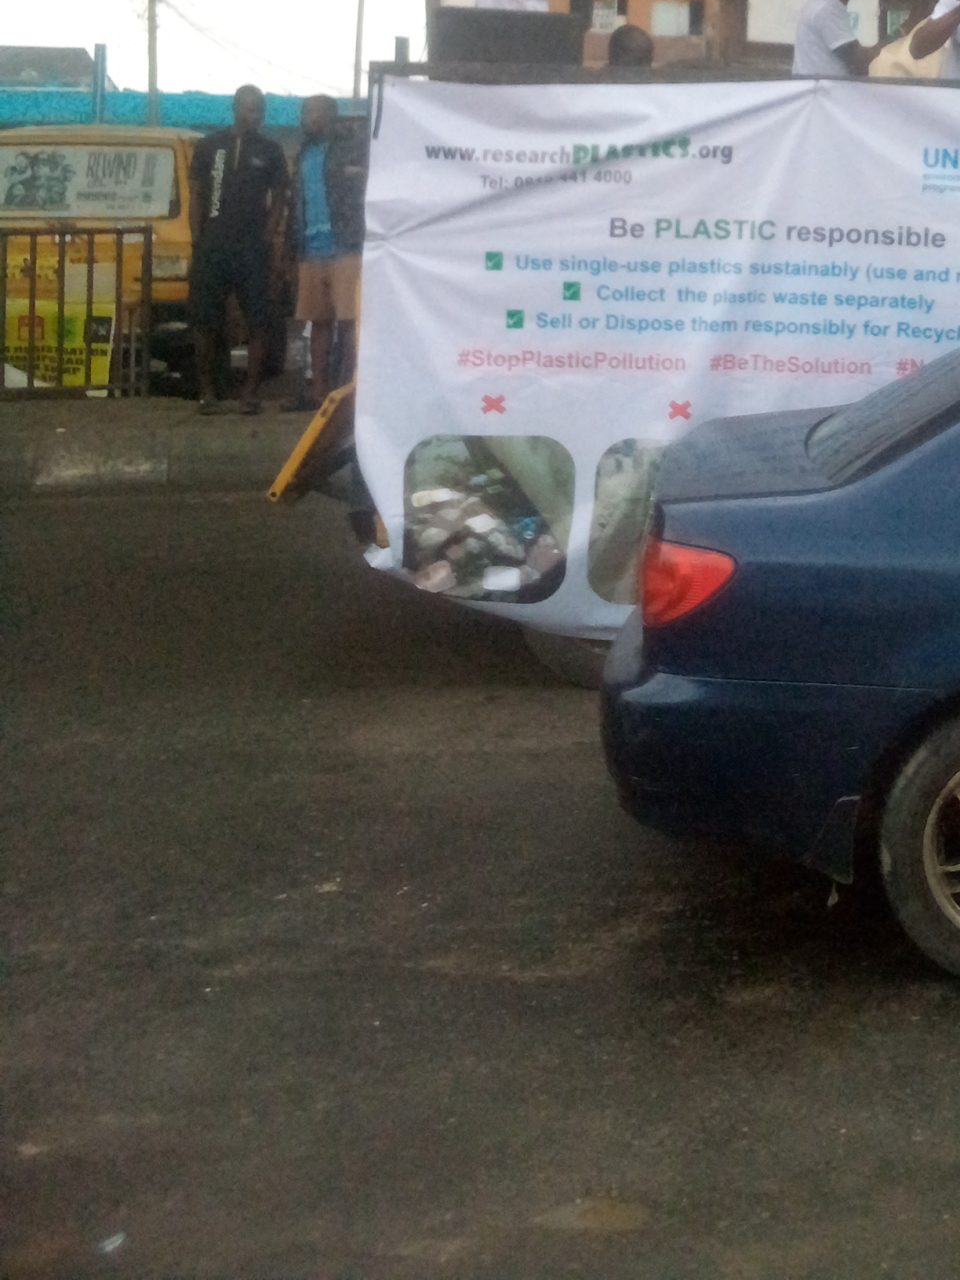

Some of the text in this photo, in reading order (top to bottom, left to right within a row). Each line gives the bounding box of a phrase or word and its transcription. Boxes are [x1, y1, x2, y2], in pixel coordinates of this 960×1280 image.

[425, 136, 733, 164] www.researchPLASTICS.org
[923, 148, 960, 169] UN
[593, 169, 632, 184] 4000
[609, 218, 947, 248] Be PLASTIC responsible
[515, 255, 553, 270] Use
[559, 255, 663, 275] single-use
[668, 257, 742, 276] plastics
[749, 261, 860, 281] sustainably
[865, 263, 907, 282] (use
[913, 267, 949, 283] and
[596, 284, 935, 314] Collect the plastic waste separately
[536, 312, 572, 328] Sell
[578, 316, 600, 329] or
[605, 314, 685, 334] Dispose
[691, 316, 738, 332] them
[744, 319, 857, 339] responsibly
[863, 320, 890, 337] for
[457, 350, 686, 371] #StopPlasticPollution
[709, 352, 872, 375] #BeTheSolution
